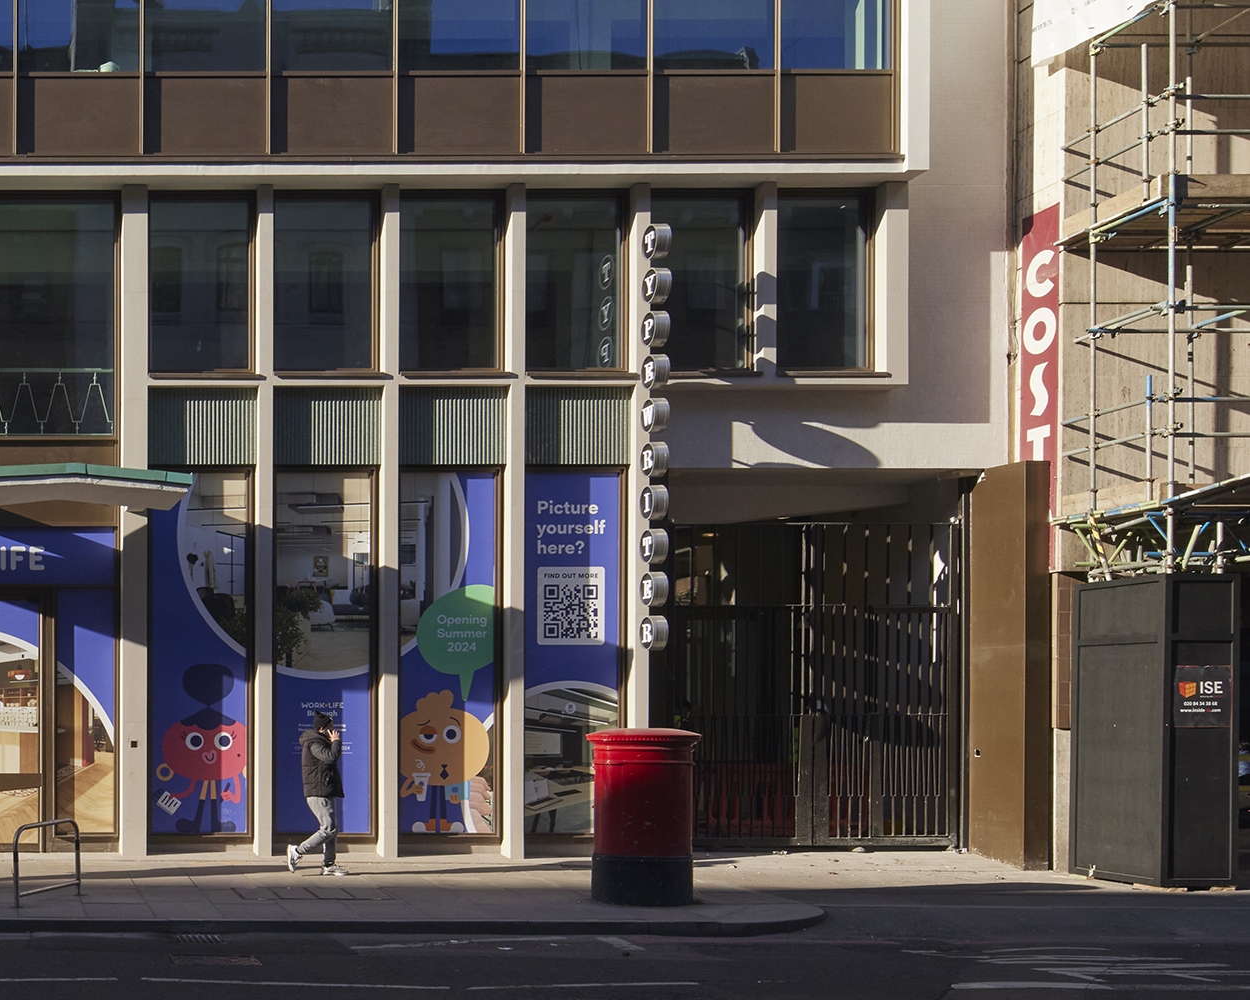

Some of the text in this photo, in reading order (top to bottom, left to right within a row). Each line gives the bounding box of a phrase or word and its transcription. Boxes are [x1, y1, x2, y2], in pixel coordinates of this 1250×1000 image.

[640, 229, 657, 644] TYPEWRITER
[536, 500, 599, 515] Picture
[536, 519, 606, 538] yourself
[536, 540, 585, 555] here?
[437, 614, 488, 627] Opening
[437, 629, 488, 638] Summer
[447, 642, 477, 652] 2024
[1200, 681, 1223, 694] ISE
